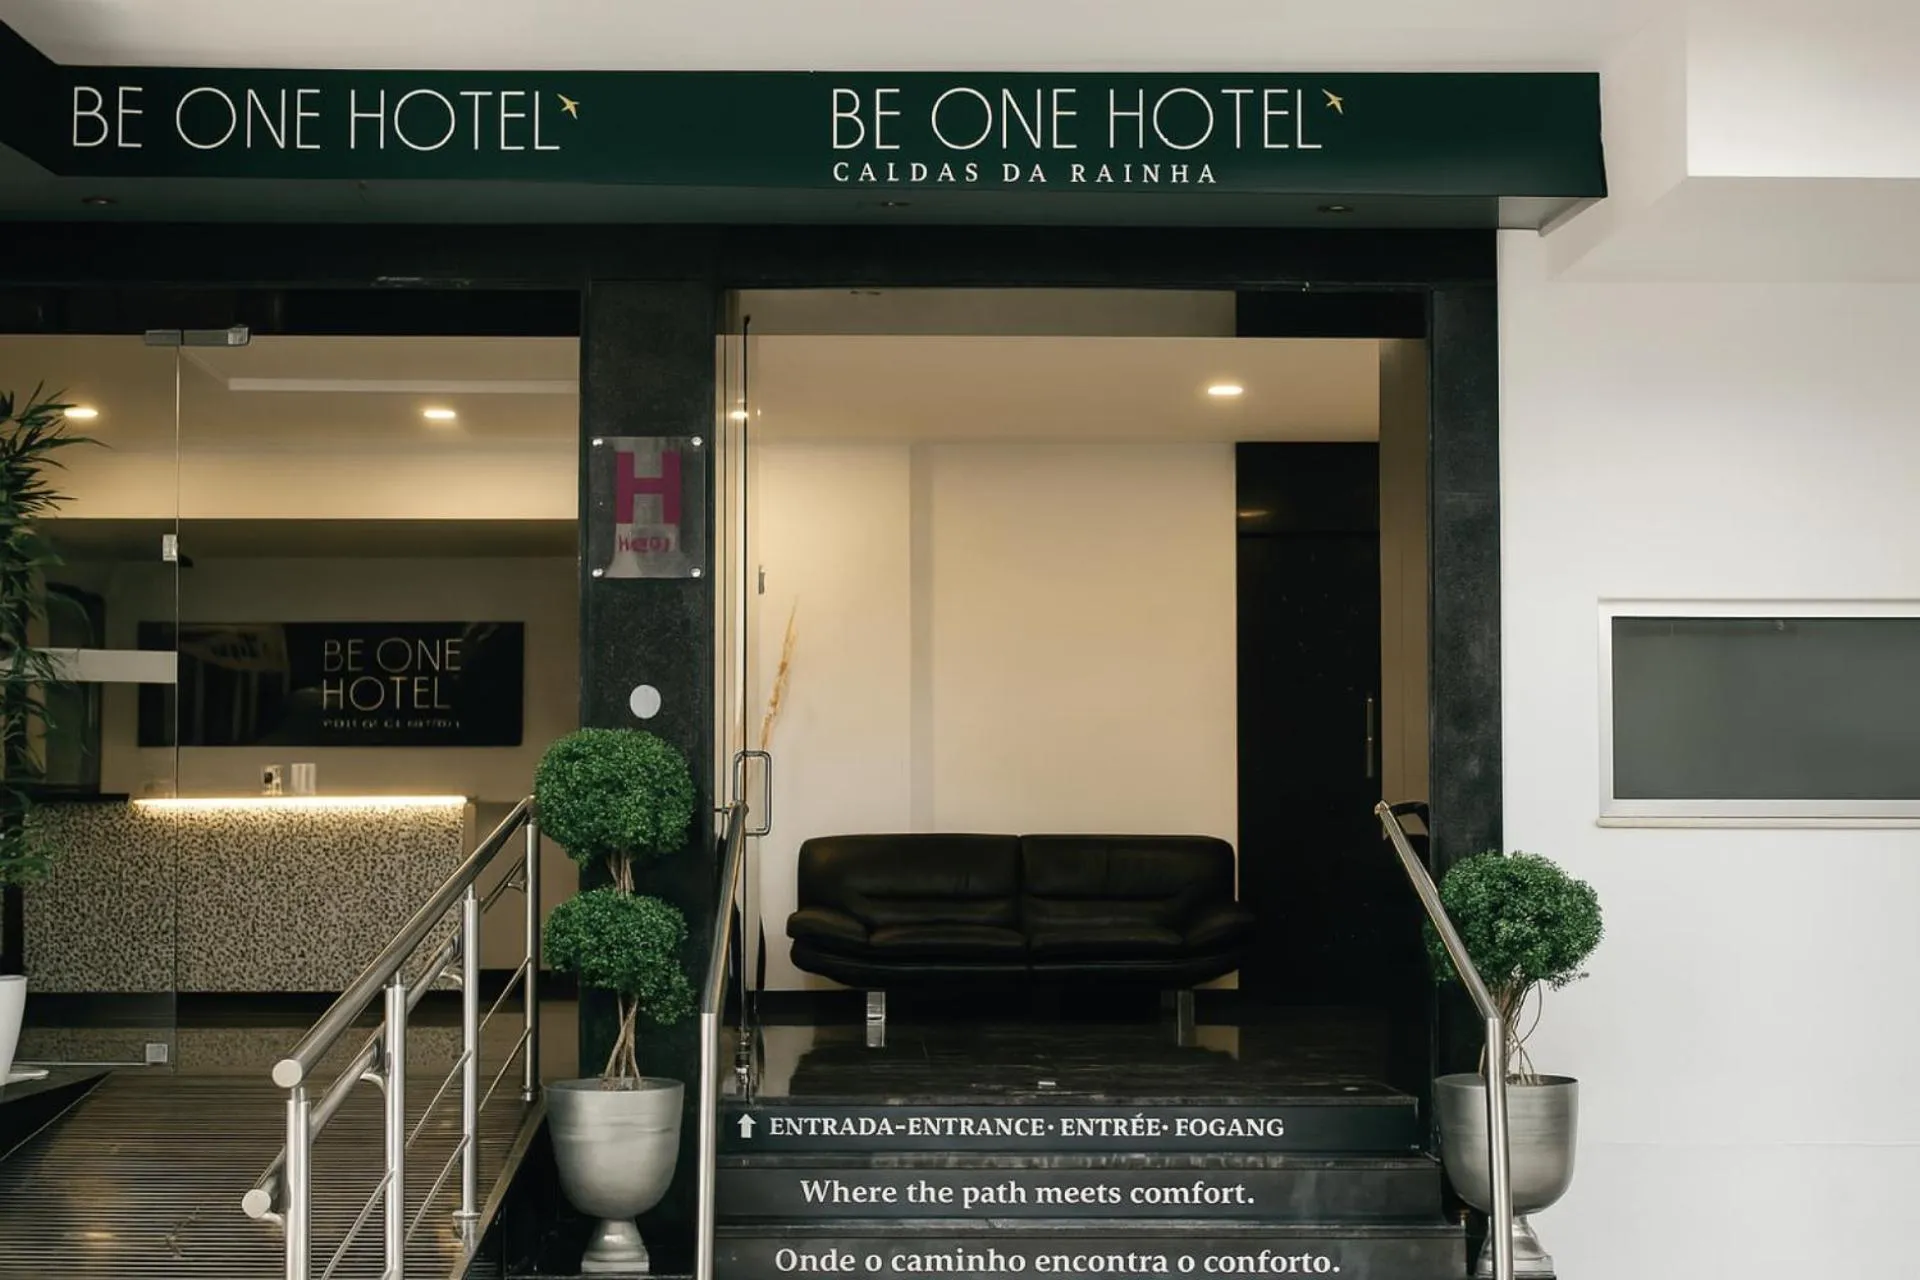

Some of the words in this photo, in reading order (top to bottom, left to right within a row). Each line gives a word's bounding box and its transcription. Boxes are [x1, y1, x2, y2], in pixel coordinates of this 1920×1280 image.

[73, 86, 143, 148] BE
[175, 87, 321, 150] ONE
[350, 88, 560, 152] HOTEL
[832, 87, 901, 150] BE
[931, 87, 1078, 151] ONE
[1109, 87, 1323, 151] HOTEL
[833, 161, 980, 184] CALDAS
[1002, 163, 1048, 184] DA
[1070, 163, 1218, 185] RAINHA
[616, 451, 682, 525] H
[323, 638, 364, 672] BE
[376, 637, 462, 673] ONE
[322, 675, 451, 711] HOTEL
[1174, 1117, 1285, 1138] FOGANG
[799, 1179, 898, 1204] Where
[906, 1179, 954, 1204] the
[961, 1180, 1028, 1210] path
[1034, 1182, 1122, 1205] meets
[1129, 1180, 1256, 1205] comfort.
[774, 1247, 856, 1273] Onde
[864, 1254, 884, 1273] o
[891, 1247, 1027, 1273] caminho
[1034, 1251, 1169, 1274] encontra
[1177, 1255, 1196, 1274] o
[1203, 1249, 1341, 1274] conforto.
